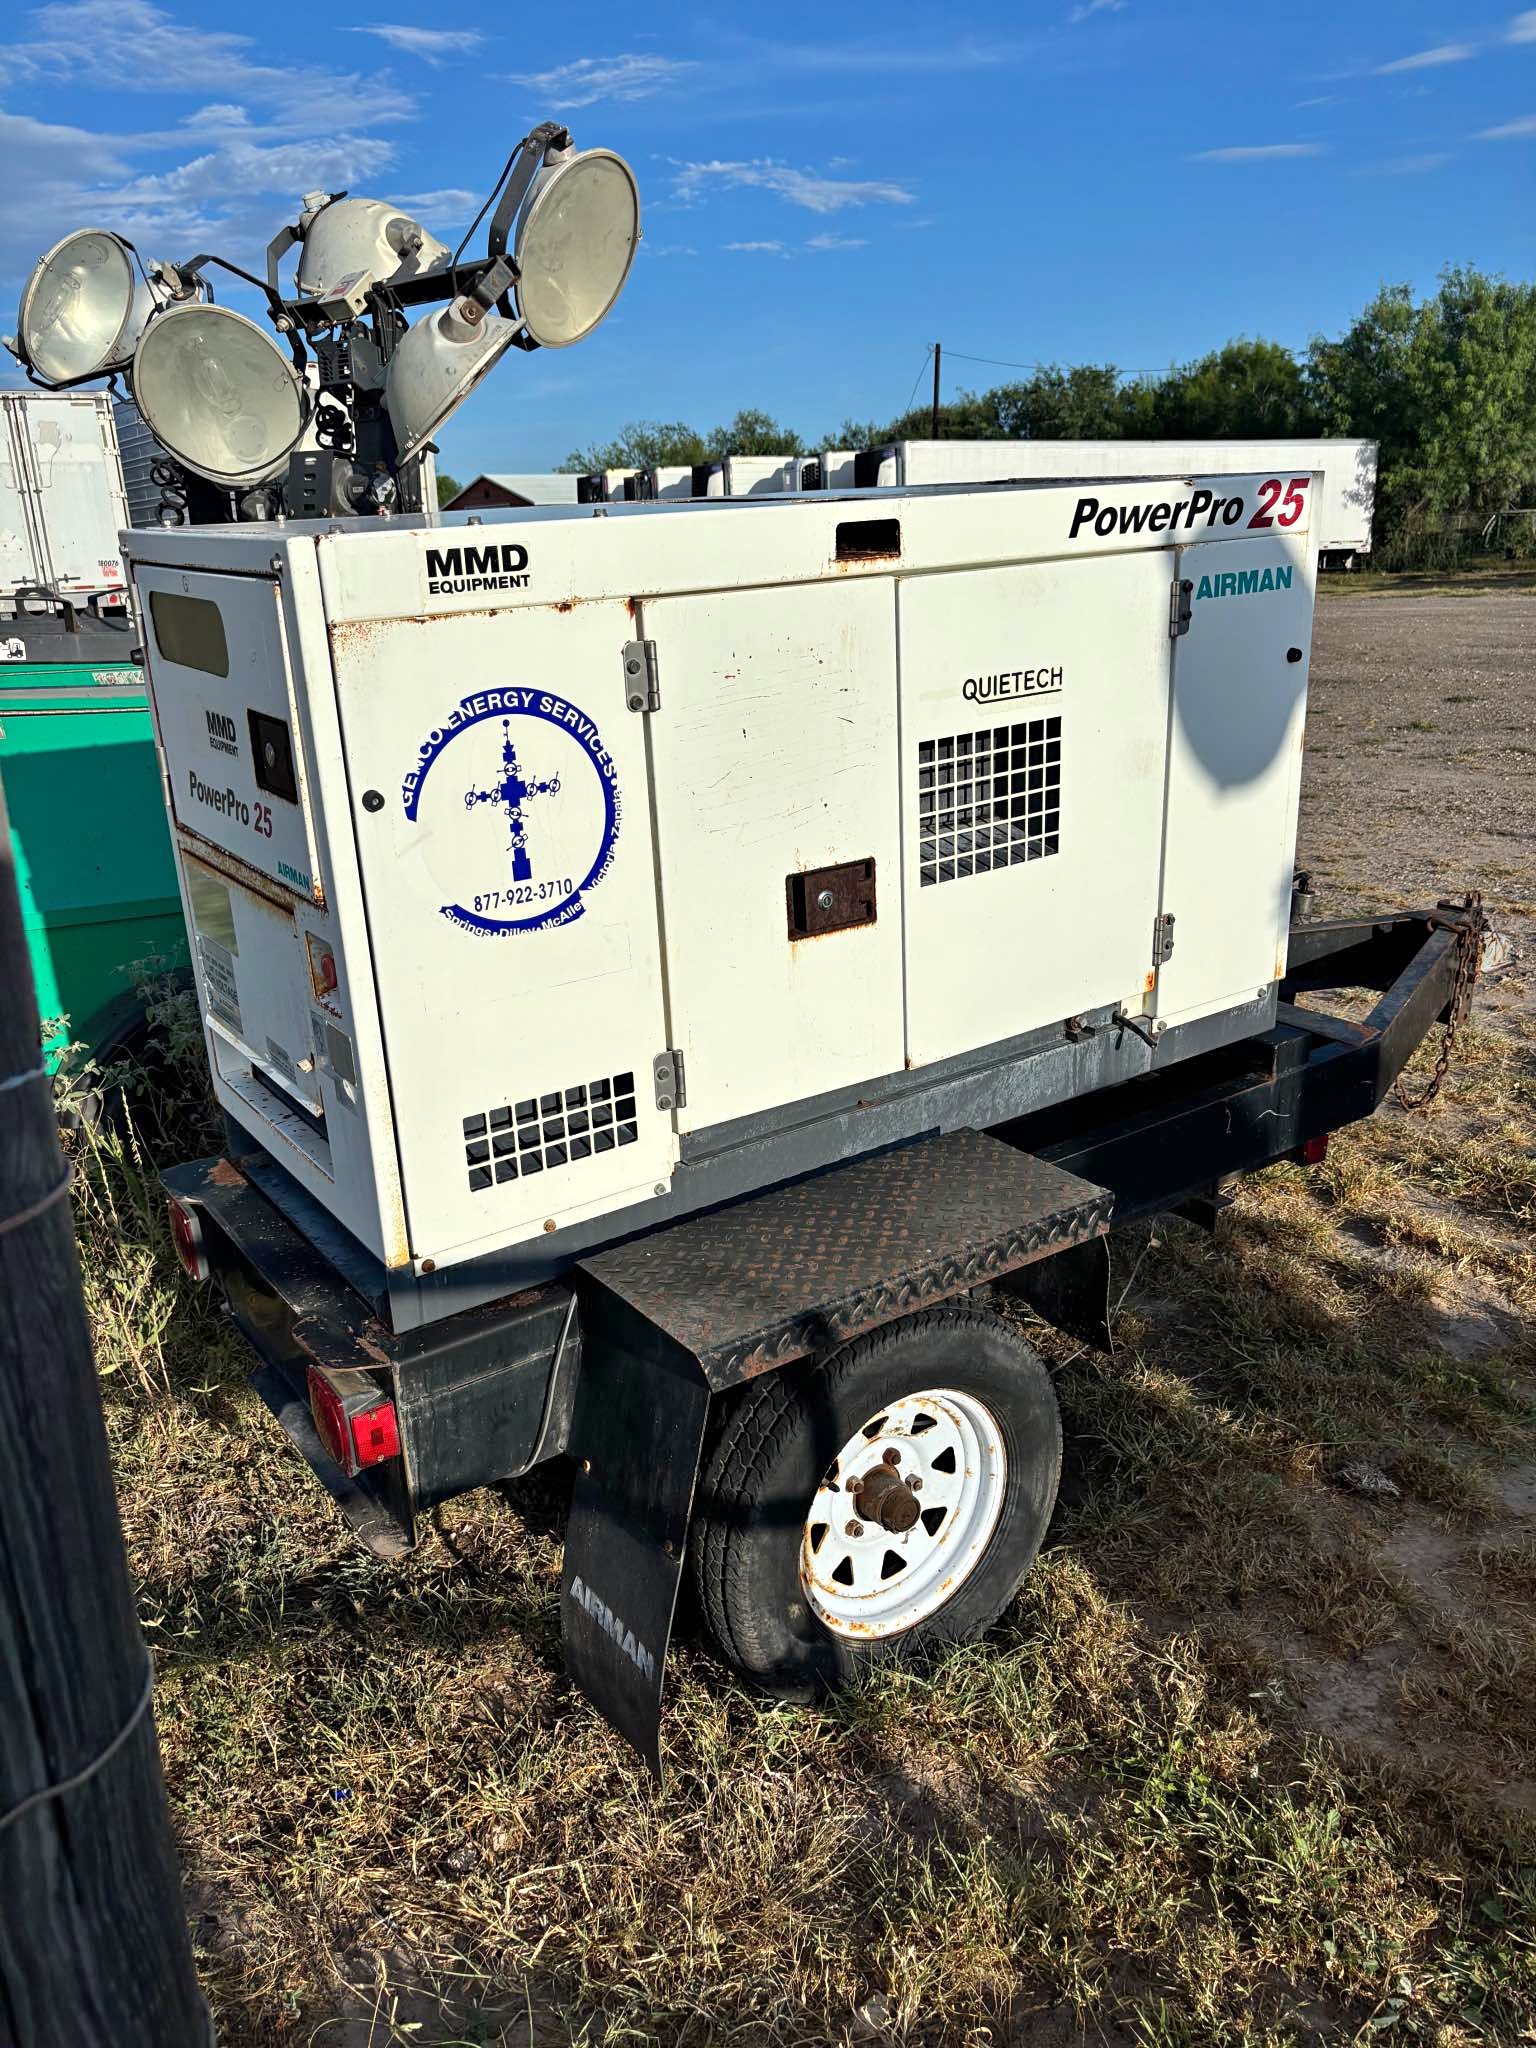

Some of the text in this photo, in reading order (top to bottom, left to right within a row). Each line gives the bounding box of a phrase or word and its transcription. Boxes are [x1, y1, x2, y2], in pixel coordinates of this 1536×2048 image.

[1069, 478, 1310, 538] PowerPro 25
[426, 544, 528, 578] MMD
[429, 574, 530, 594] EQUIPMENT
[1195, 565, 1293, 600] AIRMAN
[962, 666, 1063, 703] QUIETECH
[206, 710, 237, 743] MMD
[448, 691, 534, 730] ENERGY
[539, 696, 616, 777] SERVICES
[210, 737, 239, 758] EQUIPMENT
[189, 770, 273, 839] PowerPro 25
[277, 860, 312, 891] AIRMAN
[474, 878, 573, 912] 877-922-3710
[445, 908, 492, 937] Springs
[541, 902, 583, 930] McAlle
[570, 1575, 655, 1681] AIRMAN
